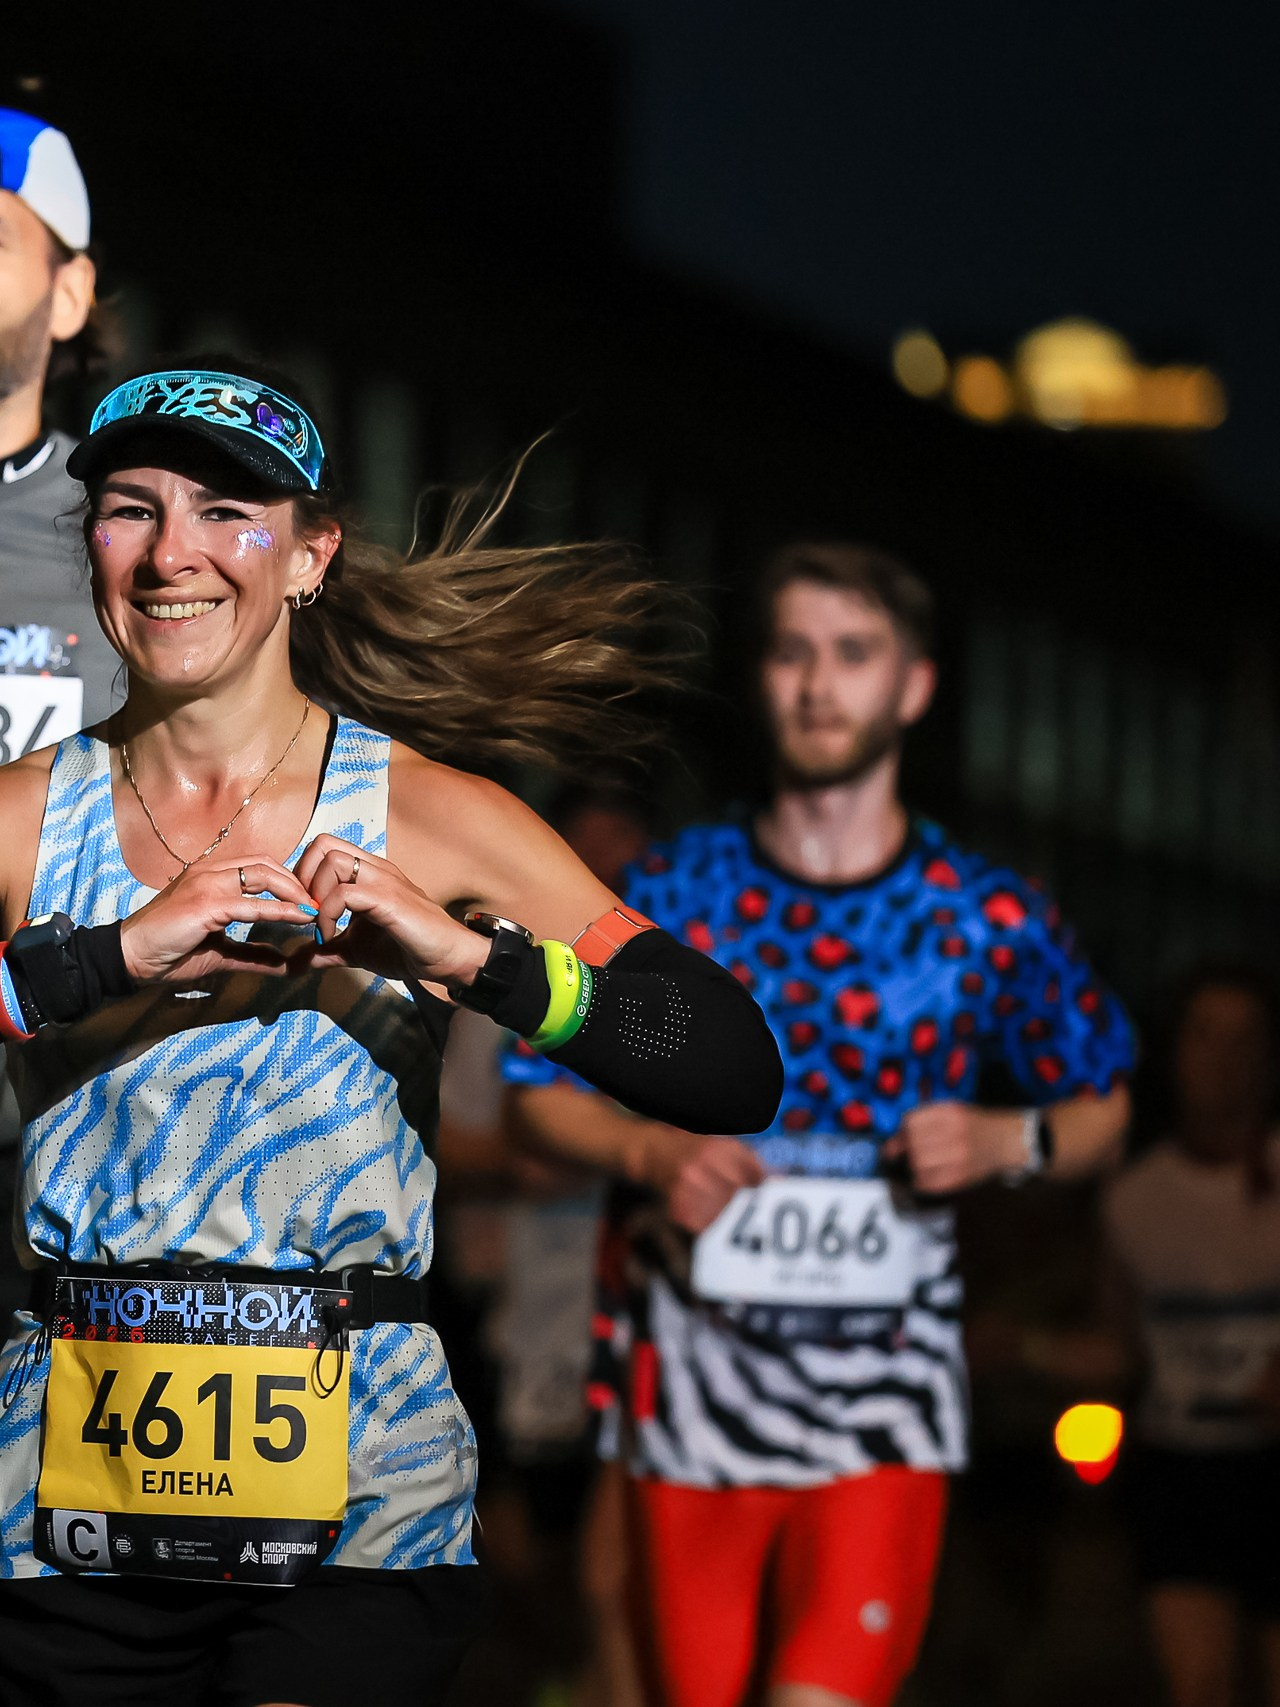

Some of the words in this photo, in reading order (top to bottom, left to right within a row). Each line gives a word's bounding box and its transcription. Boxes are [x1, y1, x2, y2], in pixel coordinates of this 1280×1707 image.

[581, 978, 590, 1004] СБЕР
[727, 1200, 889, 1264] 4066
[83, 1280, 318, 1333] НОЧНОЙ
[183, 1332, 278, 1347] ЗАБЕГ
[81, 1369, 308, 1463] 4615
[141, 1470, 234, 1497] ЕЛЕНА
[261, 1541, 318, 1555] МОСКОВСКИЙ
[261, 1553, 289, 1565] СПОРТ
